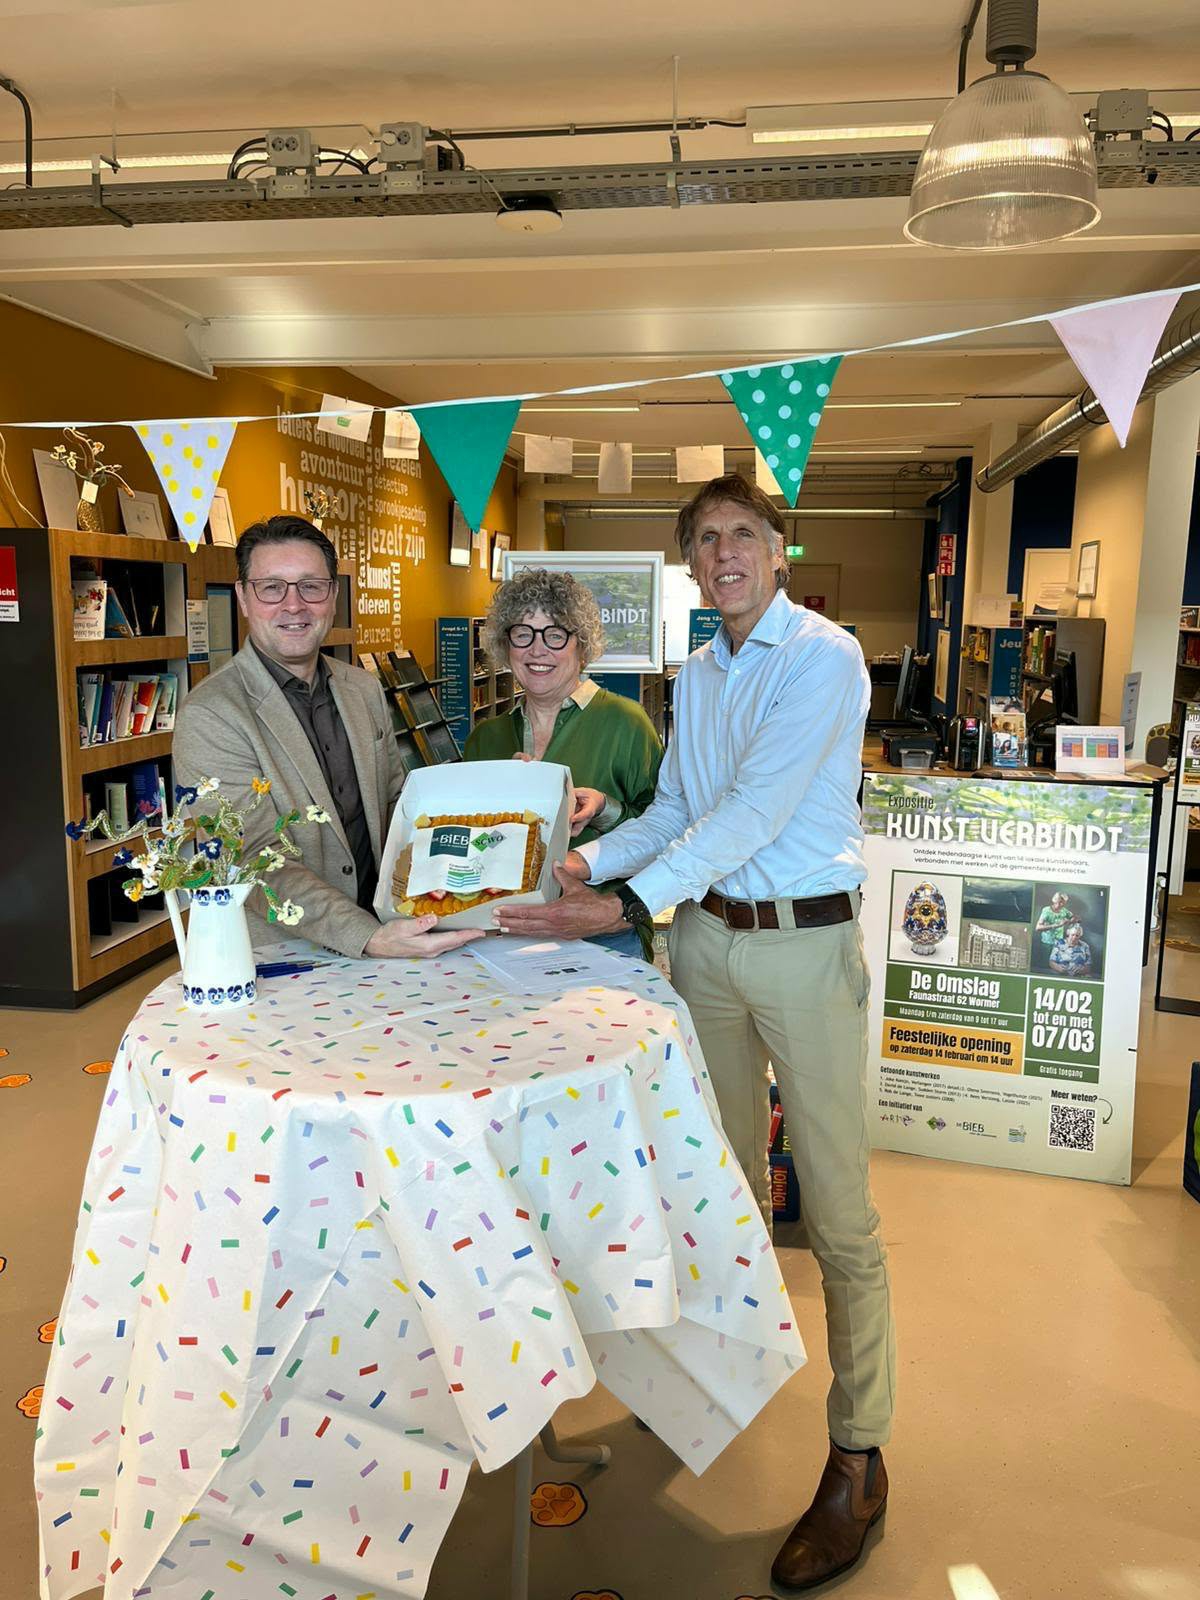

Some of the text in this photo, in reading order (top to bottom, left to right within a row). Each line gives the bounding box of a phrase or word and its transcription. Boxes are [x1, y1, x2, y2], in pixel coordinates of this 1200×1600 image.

[277, 405, 312, 443] letters
[300, 450, 365, 486] avontuur
[374, 447, 422, 479] griezelen
[279, 462, 360, 521] humor
[374, 471, 409, 496] detective
[357, 494, 367, 590] fantasy
[367, 517, 403, 561] jezelf
[405, 526, 426, 566] zijn
[366, 562, 391, 590] kunst
[358, 593, 391, 615] dieren
[601, 608, 648, 624] BINDT
[356, 624, 391, 645] leuren
[888, 794, 934, 810] Expositie
[886, 812, 1123, 853] KUNST VERBINDT
[937, 850, 982, 859] hedendaagse
[911, 970, 1001, 1000] De Omslag
[908, 990, 1000, 1009] Faunastraat 62 Wormer
[1033, 987, 1093, 1014] 14/02
[899, 1007, 1008, 1026] Maandag t/m zaterdag van 9 tot 17 uur
[1033, 1010, 1093, 1029] tot en met
[890, 1026, 1012, 1055] Feestelijke opening
[1031, 1024, 1095, 1053] 07/03
[889, 1043, 1014, 1066] op zaterdag 14 februari om 14 uur
[880, 1065, 940, 1080] Getoonde kunstwerken
[1039, 1065, 1083, 1078] Gratis toegang
[878, 1099, 923, 1112] Een initiatief van
[1051, 1089, 1098, 1102] Meer weten?
